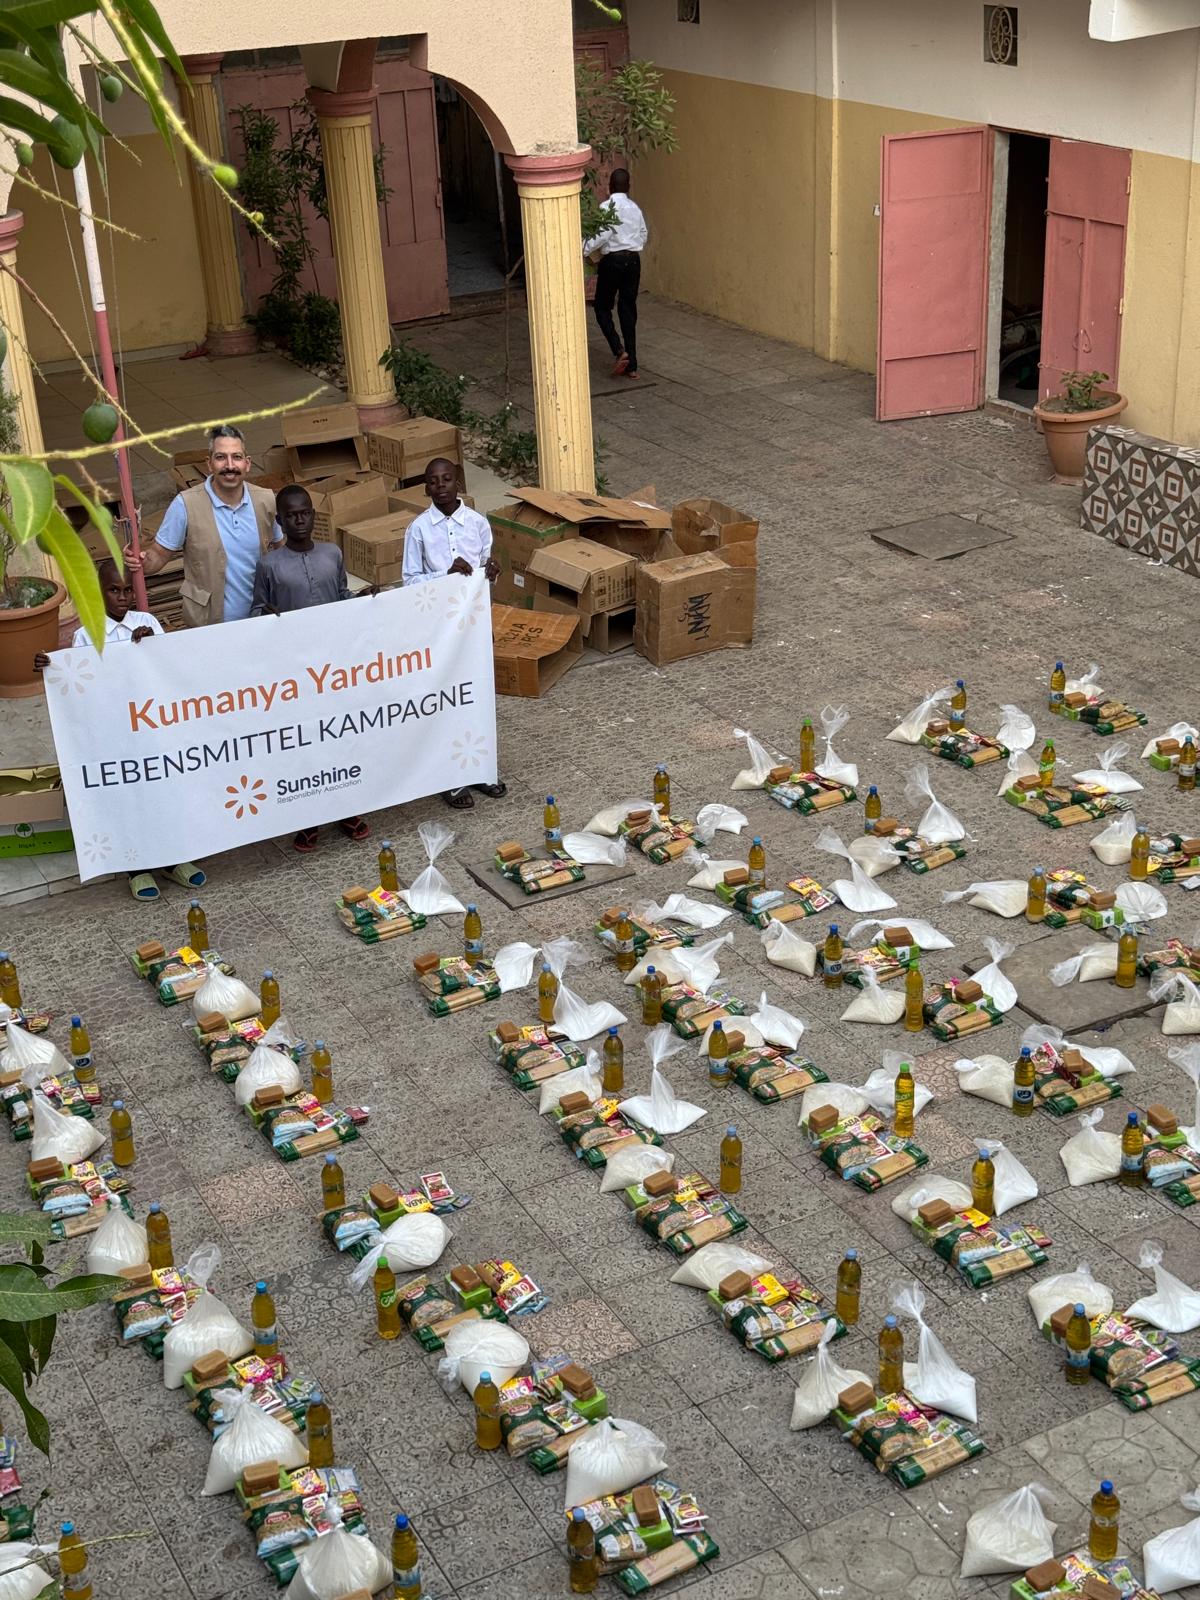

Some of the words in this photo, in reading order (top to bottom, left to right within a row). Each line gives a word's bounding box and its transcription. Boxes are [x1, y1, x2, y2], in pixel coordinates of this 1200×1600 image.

[128, 678, 299, 732] Kumanya
[306, 647, 433, 694] Yardımı
[81, 724, 313, 789] LEBENSMITTEL
[319, 682, 475, 742] KAMPAGNE
[276, 765, 362, 796] Sunshine
[276, 787, 323, 805] Responsibility
[324, 778, 362, 793] Association
